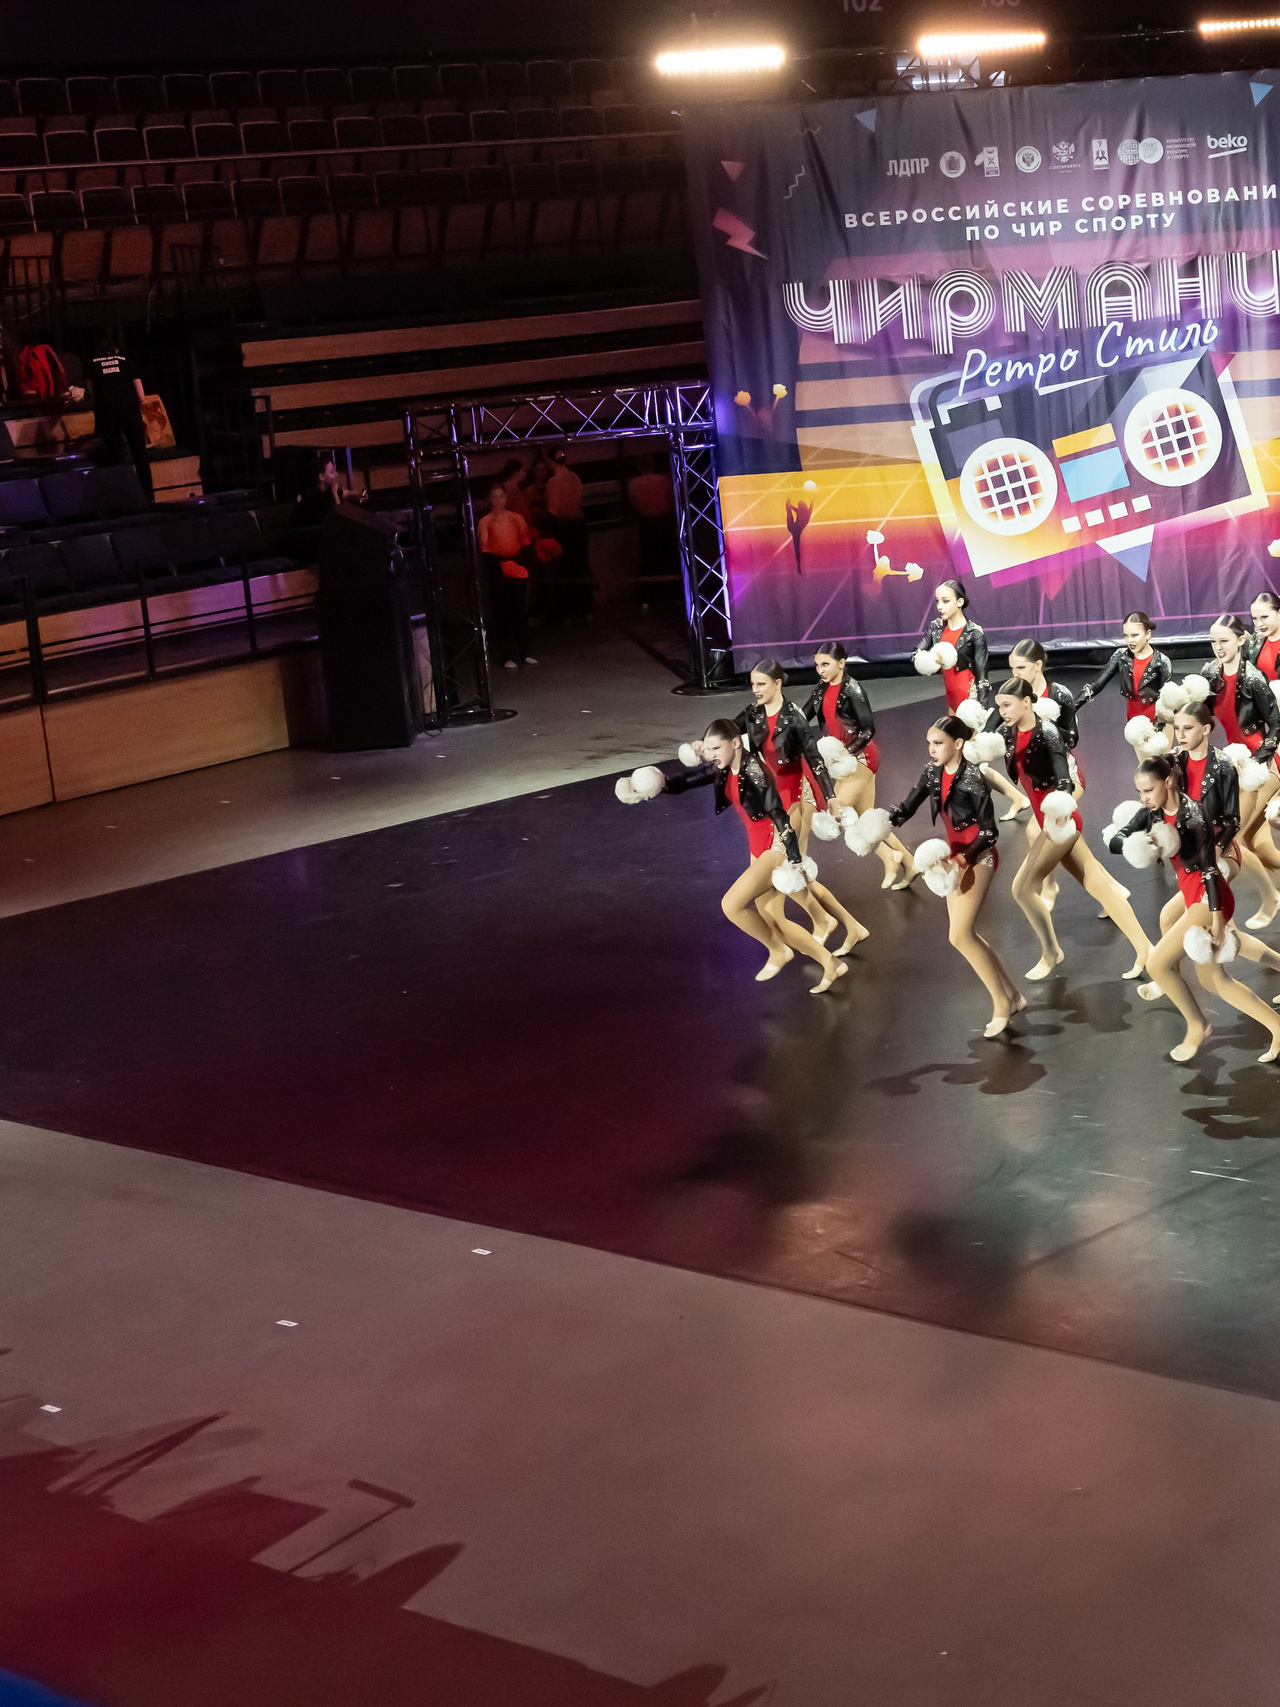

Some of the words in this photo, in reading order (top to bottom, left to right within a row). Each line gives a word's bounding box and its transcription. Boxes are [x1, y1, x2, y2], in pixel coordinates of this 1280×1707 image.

[1206, 133, 1248, 149] beko
[886, 157, 931, 178] ЛДПР
[844, 199, 1070, 228] ВСЕРОССИЙСКИЕ
[965, 225, 1000, 242] ПО
[1011, 220, 1063, 239] ЧИР
[1074, 212, 1176, 234] СПОРТУ
[957, 348, 1080, 398] Ретро
[1095, 318, 1219, 369] Стиль
